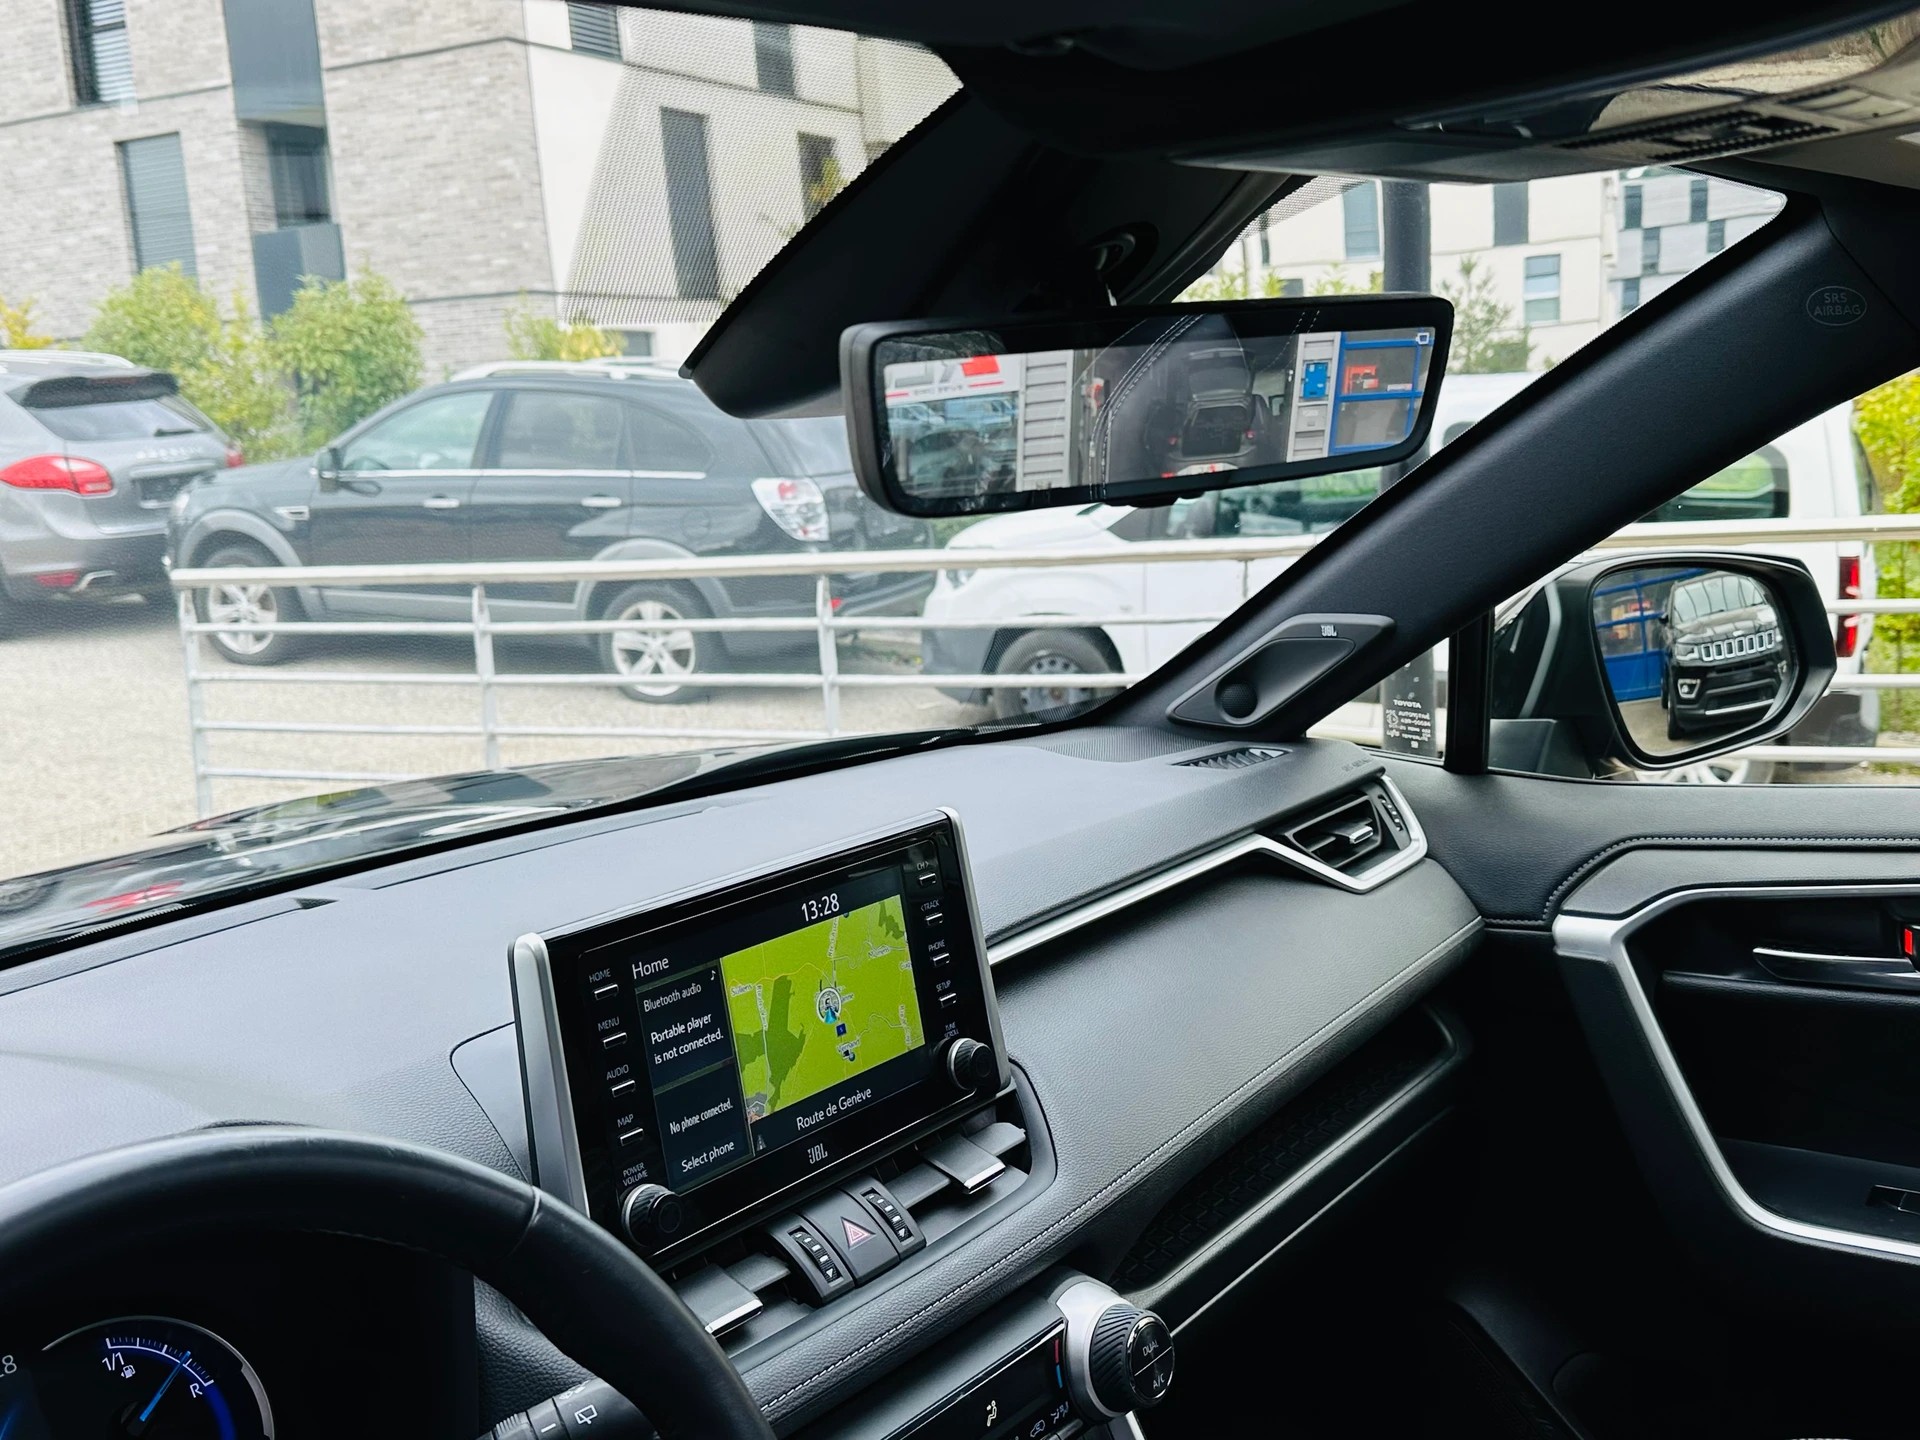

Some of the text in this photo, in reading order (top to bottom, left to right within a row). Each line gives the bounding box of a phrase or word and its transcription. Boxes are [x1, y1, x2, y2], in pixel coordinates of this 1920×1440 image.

[1823, 292, 1848, 303] SRS
[1813, 304, 1861, 316] AIRBAG
[1320, 624, 1337, 637] JBL
[1393, 699, 1421, 708] TOYOTA
[801, 892, 840, 921] 13:28
[928, 938, 946, 952] PHONE
[589, 968, 611, 983] HOME
[632, 958, 670, 980] Home
[935, 980, 951, 992] SETUP
[643, 983, 702, 1012] Bluetooth audio
[597, 1016, 620, 1032] MENU
[650, 1013, 712, 1045] Portable player
[654, 1028, 724, 1065] is not connected.
[606, 1064, 629, 1080] AUDIO
[669, 1122, 681, 1135] No
[681, 1114, 700, 1132] phone
[700, 1097, 733, 1121] connected.
[796, 1088, 872, 1131] Route de Genève
[617, 1114, 634, 1128] MAP
[681, 1141, 735, 1173] Select phone
[807, 1143, 829, 1165] JBL
[622, 1162, 645, 1177] POWER
[622, 1170, 649, 1187] VOLUME
[1143, 1340, 1159, 1356] DUAL
[0, 1354, 17, 1378] 8
[102, 1352, 125, 1371] 1/1
[1152, 1373, 1165, 1390] A/C
[189, 1382, 203, 1398] R
